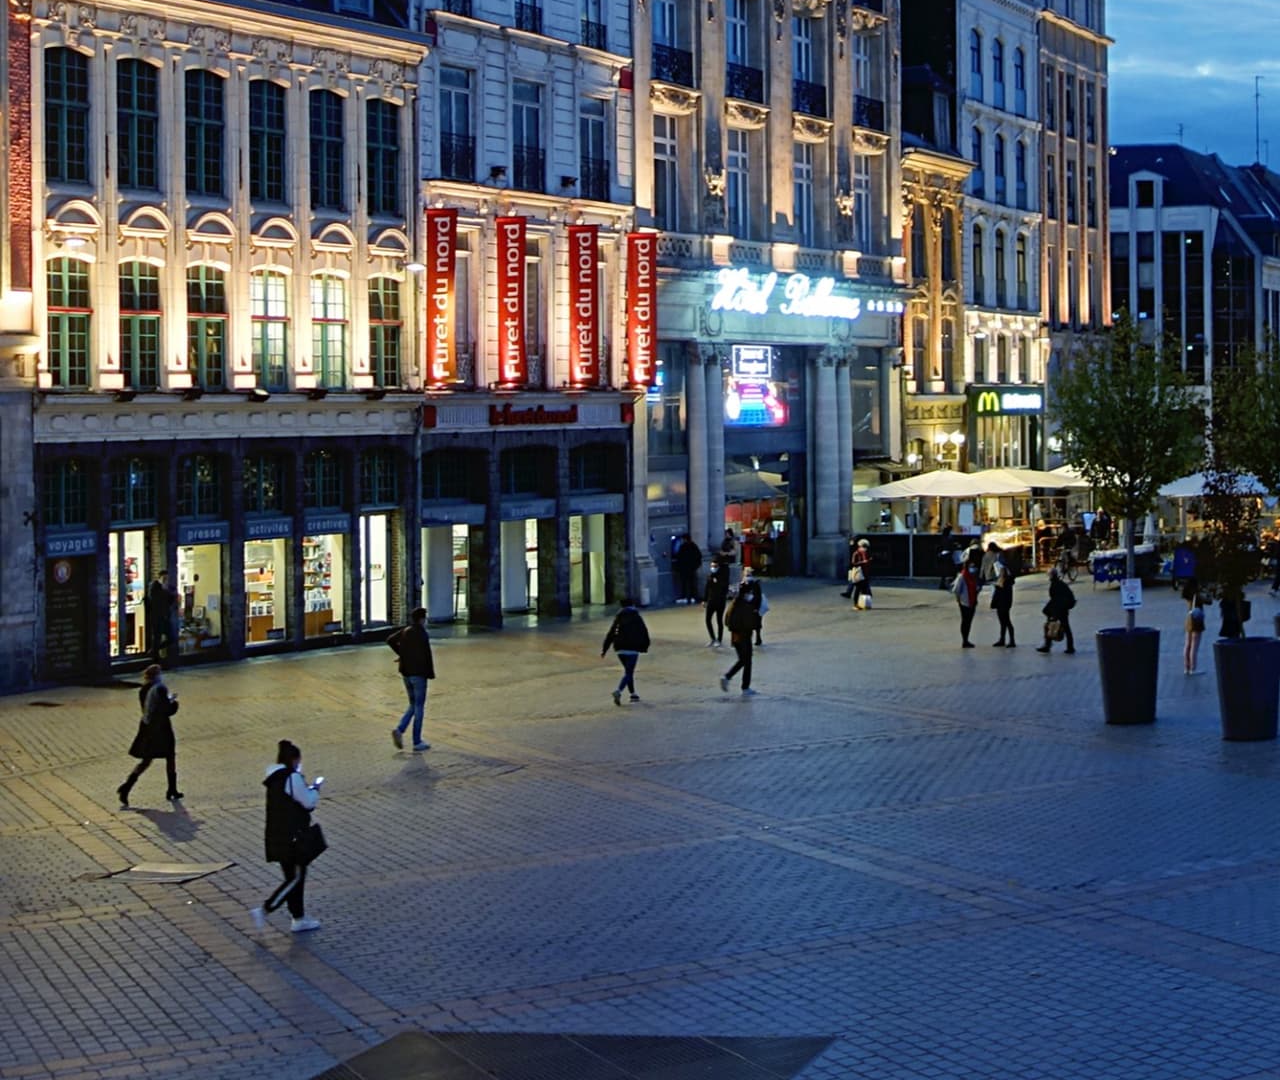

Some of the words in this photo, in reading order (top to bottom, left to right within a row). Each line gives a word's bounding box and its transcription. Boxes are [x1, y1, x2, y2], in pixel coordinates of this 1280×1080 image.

[433, 216, 450, 272] nord
[503, 223, 520, 276] nord
[576, 232, 592, 282] nord
[634, 239, 651, 284] nord
[432, 278, 449, 309] du
[503, 282, 520, 313] du
[575, 289, 592, 317] du
[634, 292, 651, 321] du
[433, 314, 449, 377] Furet
[504, 318, 521, 378] Furet
[576, 322, 592, 379] Furet
[634, 325, 650, 381] Furet
[47, 538, 95, 552] voyages
